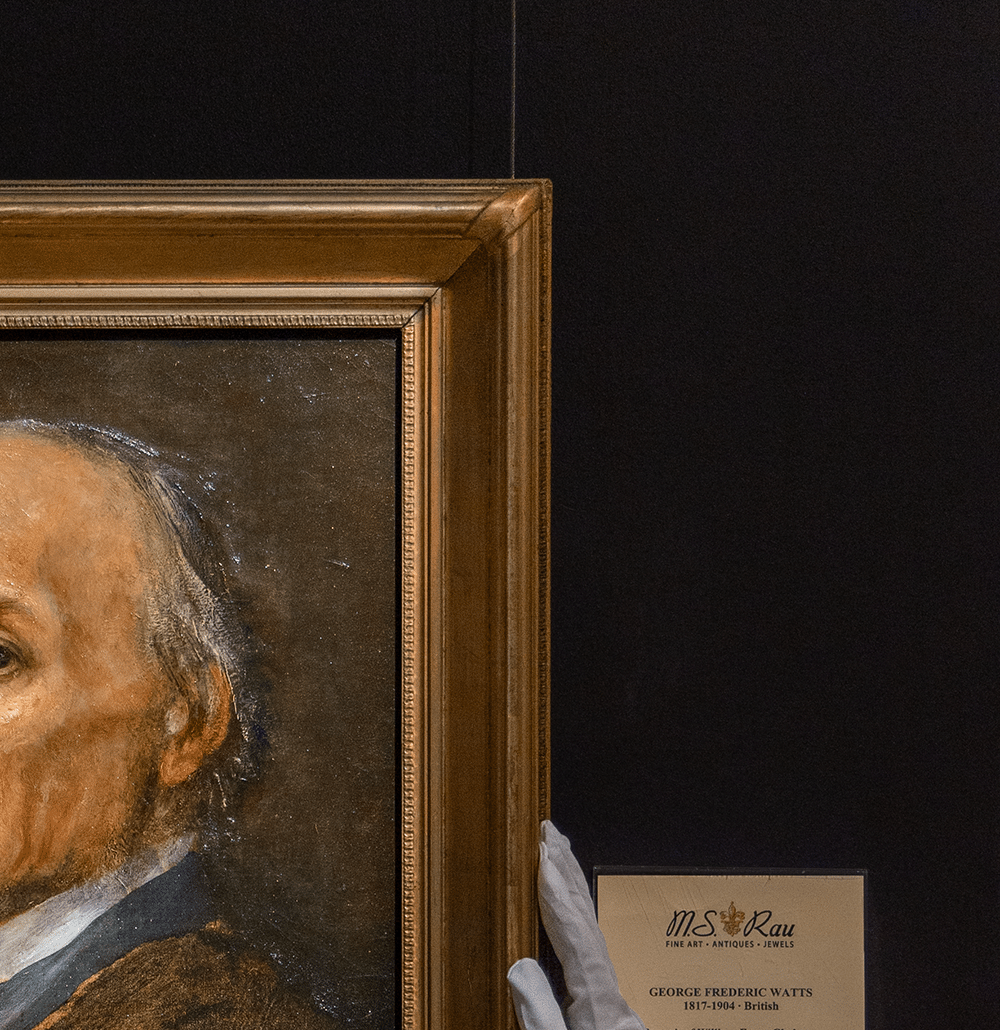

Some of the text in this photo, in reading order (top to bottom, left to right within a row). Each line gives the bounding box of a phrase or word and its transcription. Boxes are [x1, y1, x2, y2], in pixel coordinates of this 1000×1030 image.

[743, 910, 796, 937] Rau
[665, 940, 795, 949] FINE ART ANTIQUES JEWELS
[649, 987, 813, 997] GEORGE FREDERIC WATTS
[683, 1001, 779, 1011] 1817-1904 British
